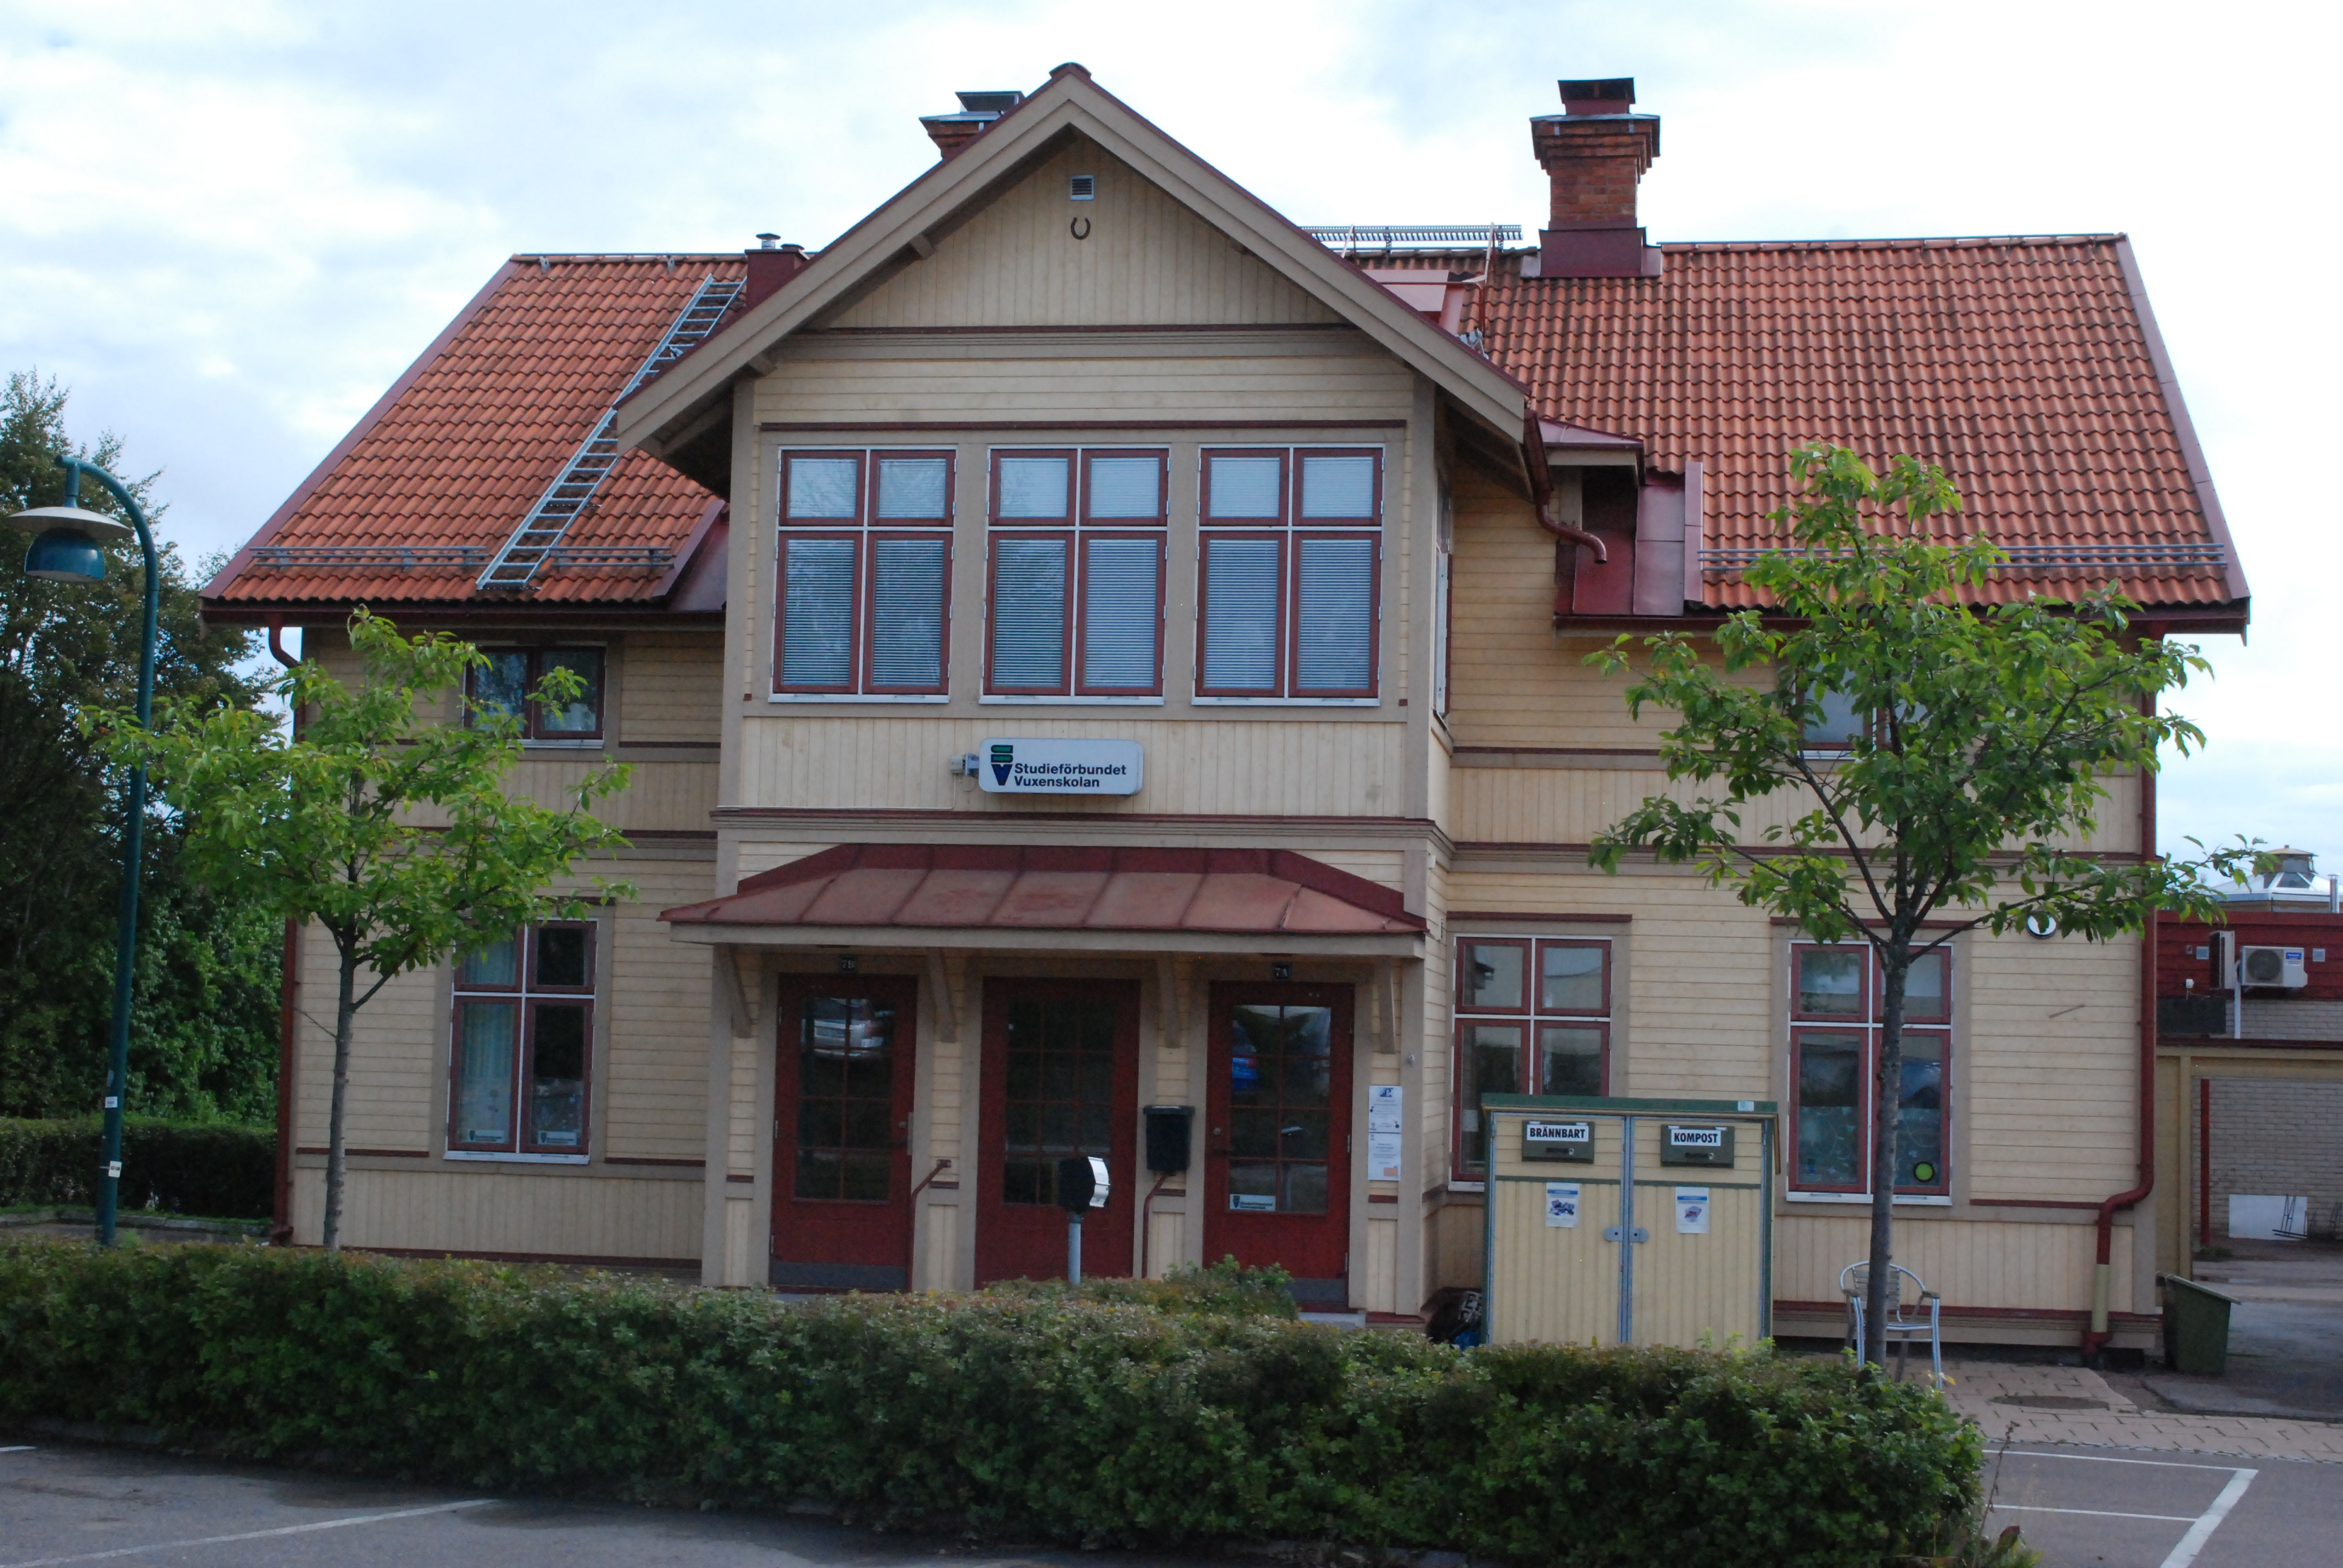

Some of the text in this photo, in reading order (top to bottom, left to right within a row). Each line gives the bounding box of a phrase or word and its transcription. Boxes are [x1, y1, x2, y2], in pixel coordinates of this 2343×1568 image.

[1014, 763, 1127, 775] Studieförbundet
[1014, 776, 1100, 787] Vuxenskolan
[1530, 1126, 1585, 1138] BRÄNNBART
[1674, 1132, 1718, 1143] KOMPOST
